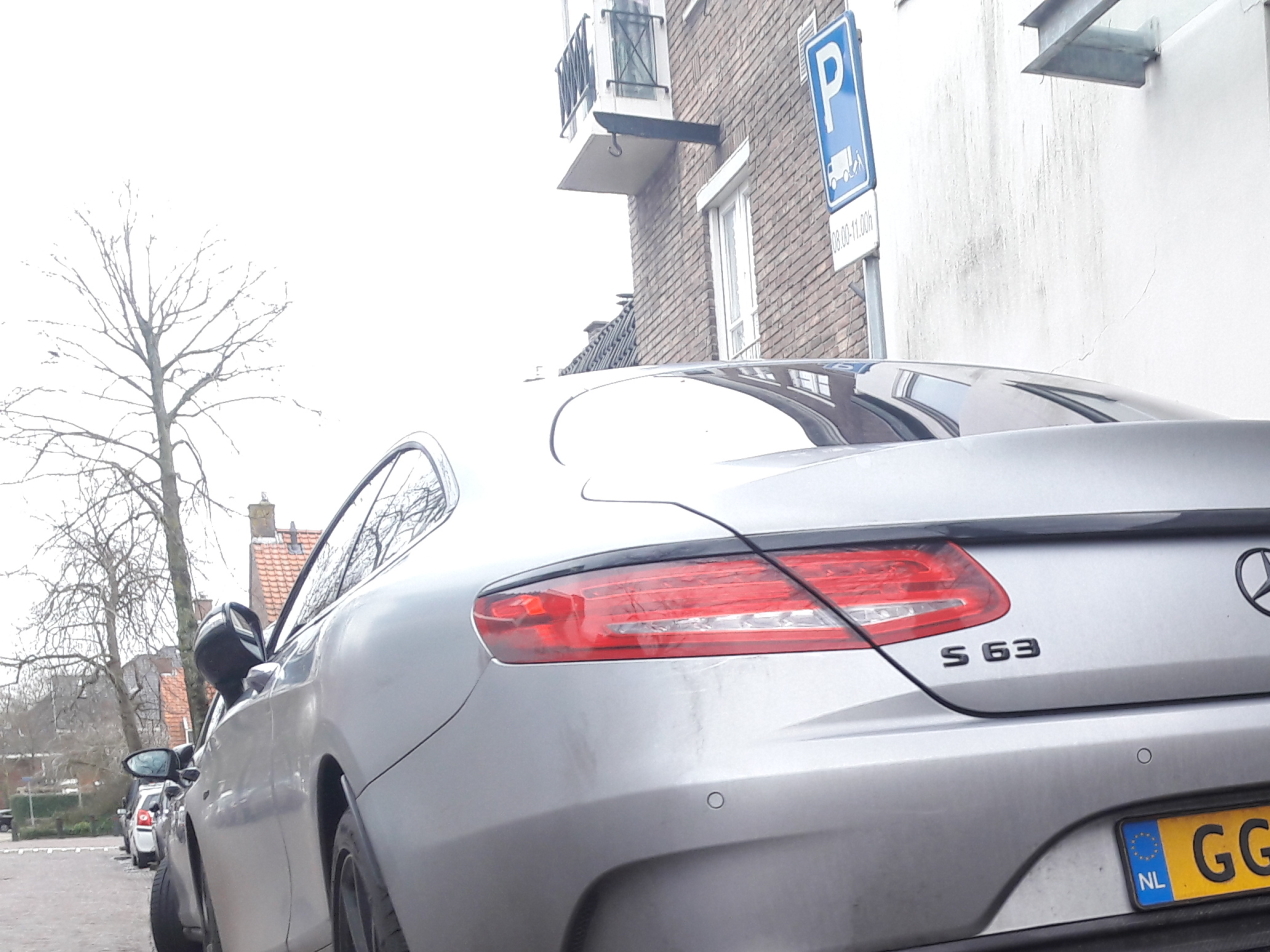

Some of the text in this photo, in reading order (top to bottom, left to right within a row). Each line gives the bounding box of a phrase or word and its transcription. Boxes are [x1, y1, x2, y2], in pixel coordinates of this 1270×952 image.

[816, 41, 844, 133] P
[941, 638, 1041, 668] S 63
[1138, 871, 1166, 892] NL
